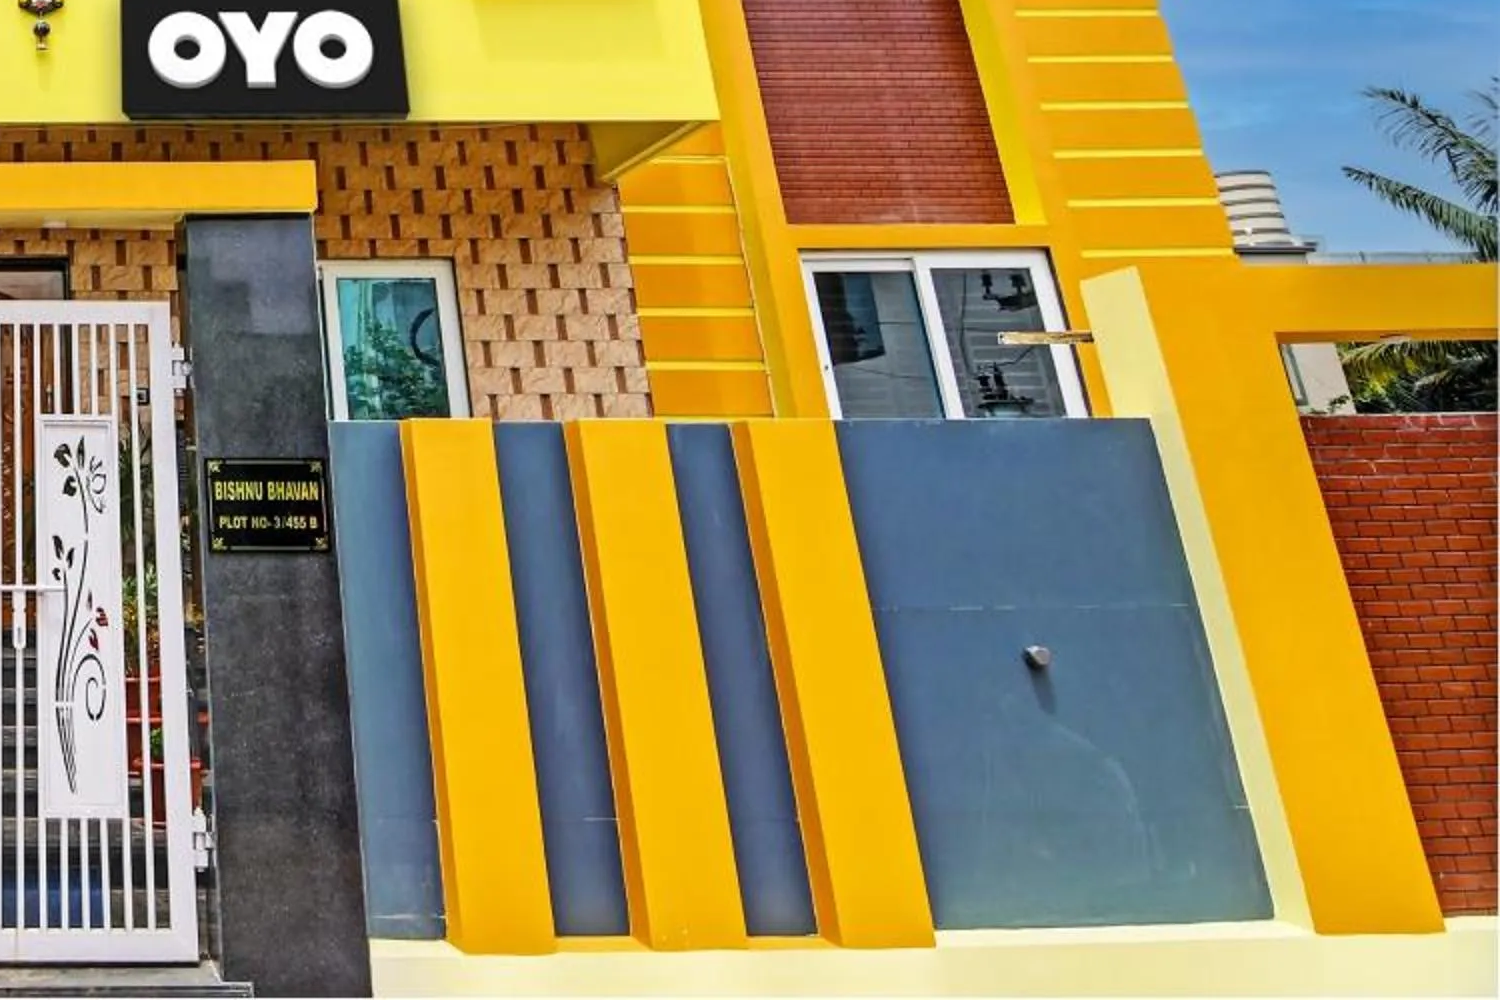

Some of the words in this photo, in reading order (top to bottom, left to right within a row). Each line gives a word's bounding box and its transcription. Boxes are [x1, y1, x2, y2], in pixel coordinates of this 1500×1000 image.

[147, 9, 374, 89] OYO
[215, 481, 263, 500] BISHNU
[267, 481, 319, 500] BHAVAN
[220, 516, 248, 529] PLOT
